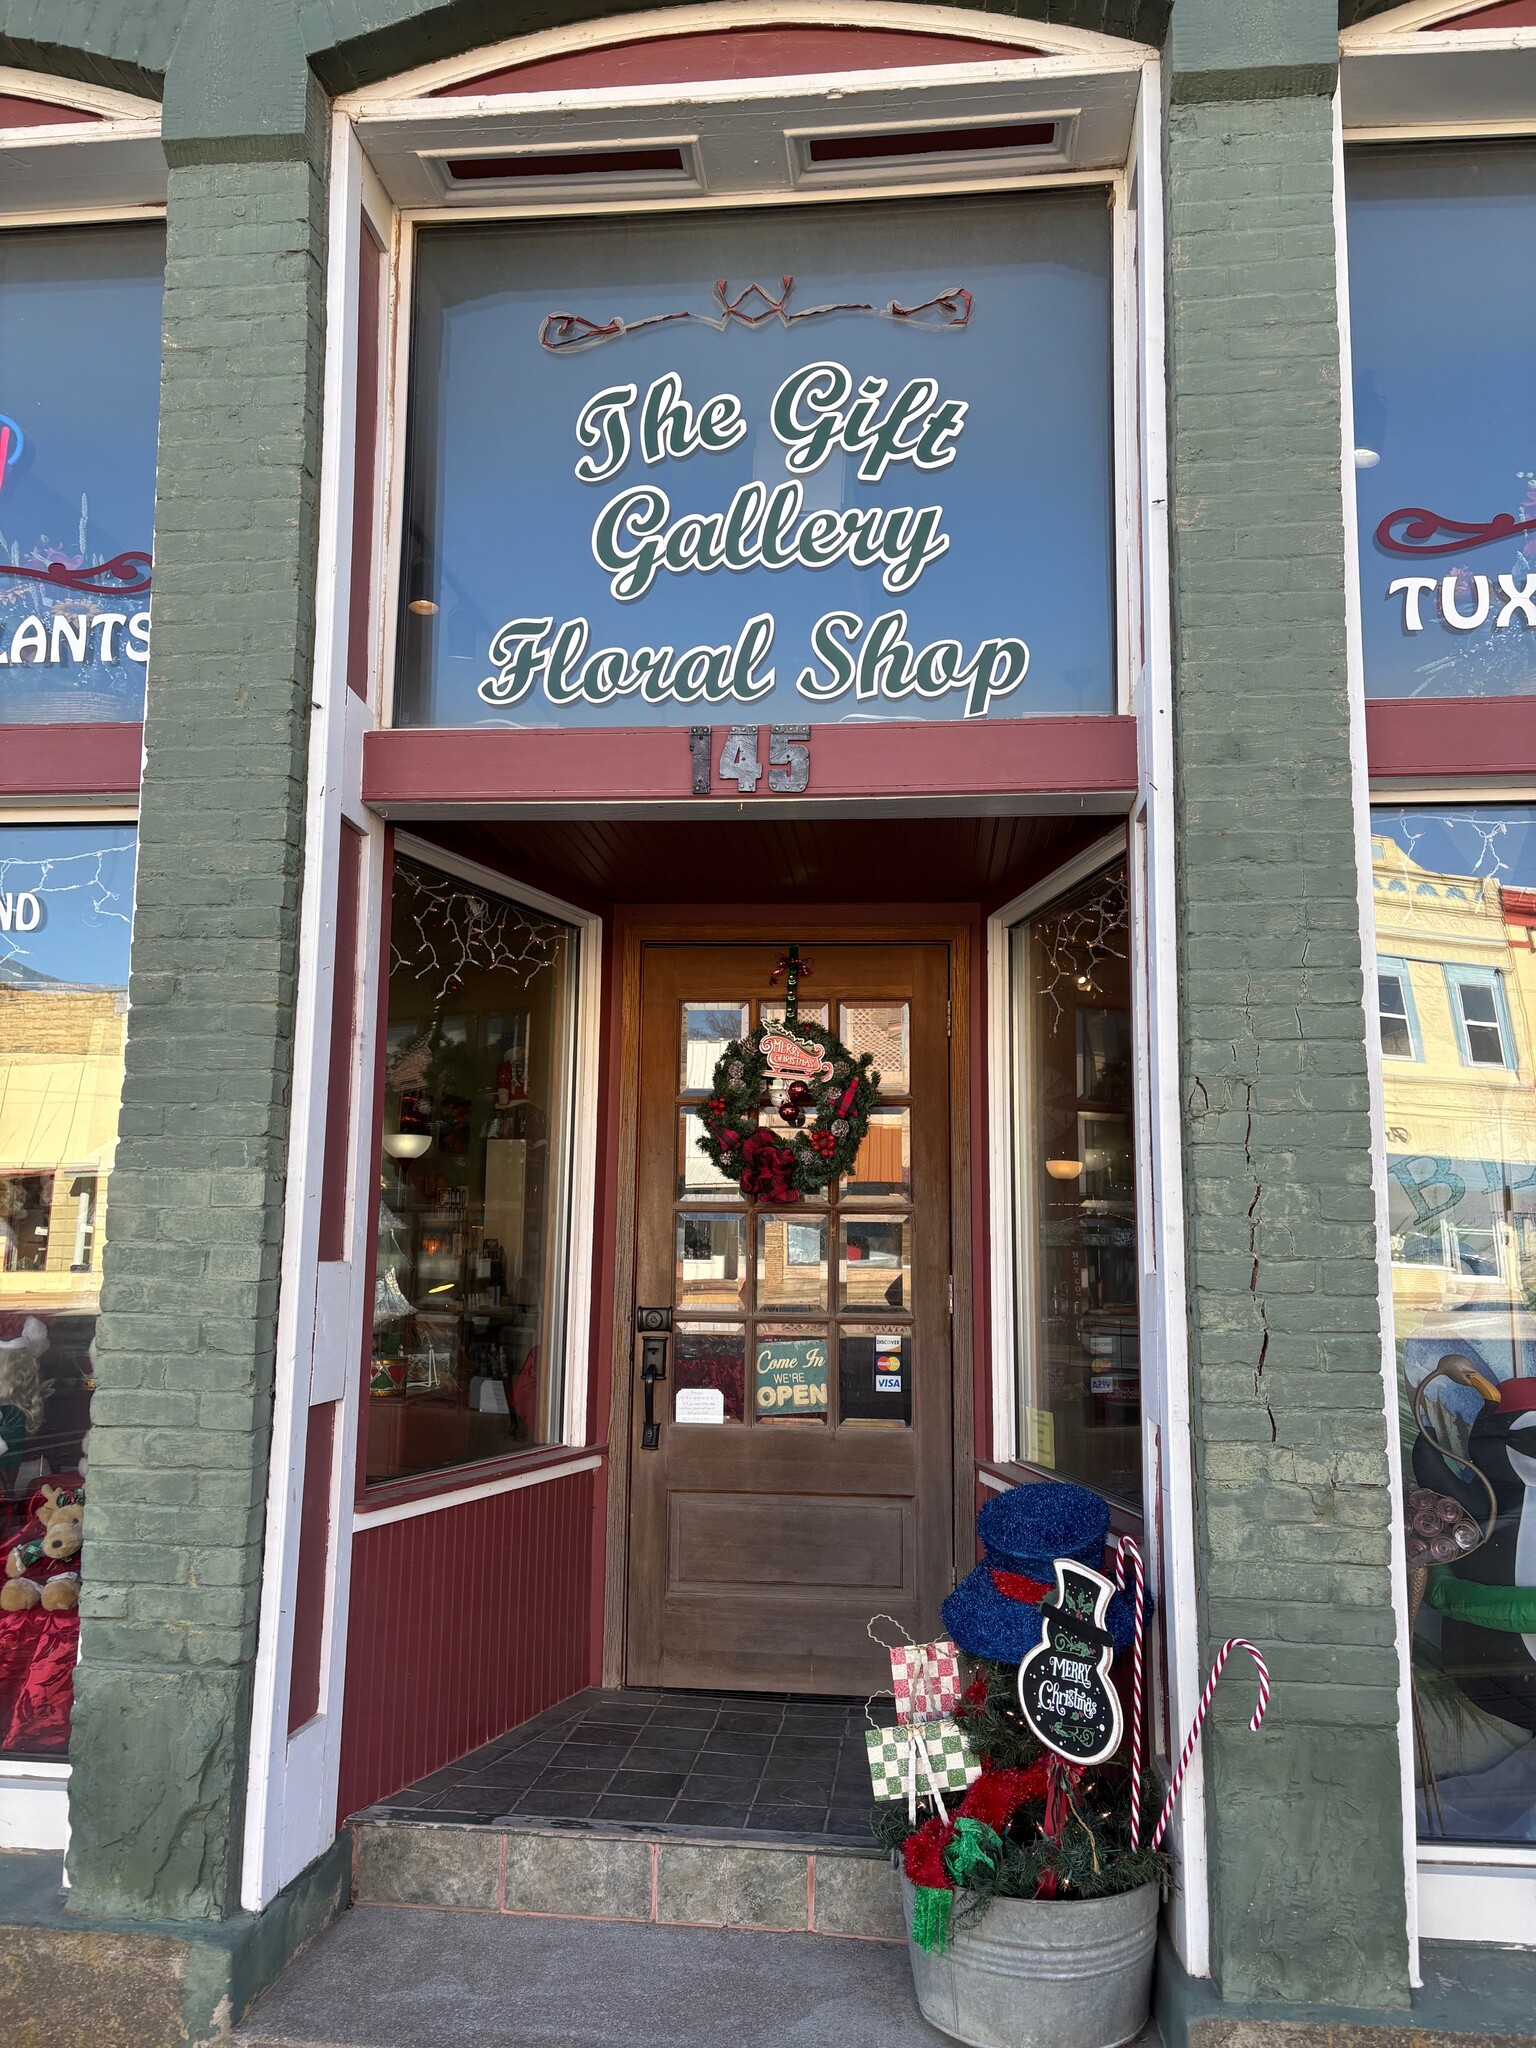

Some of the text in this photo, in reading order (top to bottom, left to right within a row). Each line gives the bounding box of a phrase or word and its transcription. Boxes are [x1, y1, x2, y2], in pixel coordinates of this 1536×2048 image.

[575, 361, 968, 481] The Gift
[592, 480, 949, 600] Gallery
[1389, 573, 1536, 631] TUX
[0, 611, 150, 663] ANTS
[478, 609, 1030, 719] Floral Shop
[689, 724, 811, 795] 145
[773, 1039, 801, 1057] MERRY
[774, 1054, 815, 1068] CHRISTMAS
[756, 1348, 825, 1375] Come In
[773, 1372, 805, 1384] WE'RE
[756, 1383, 827, 1408] OPEN
[878, 1379, 901, 1388] VISA
[1050, 1656, 1093, 1688] MERRY
[1037, 1680, 1098, 1719] Christmas
